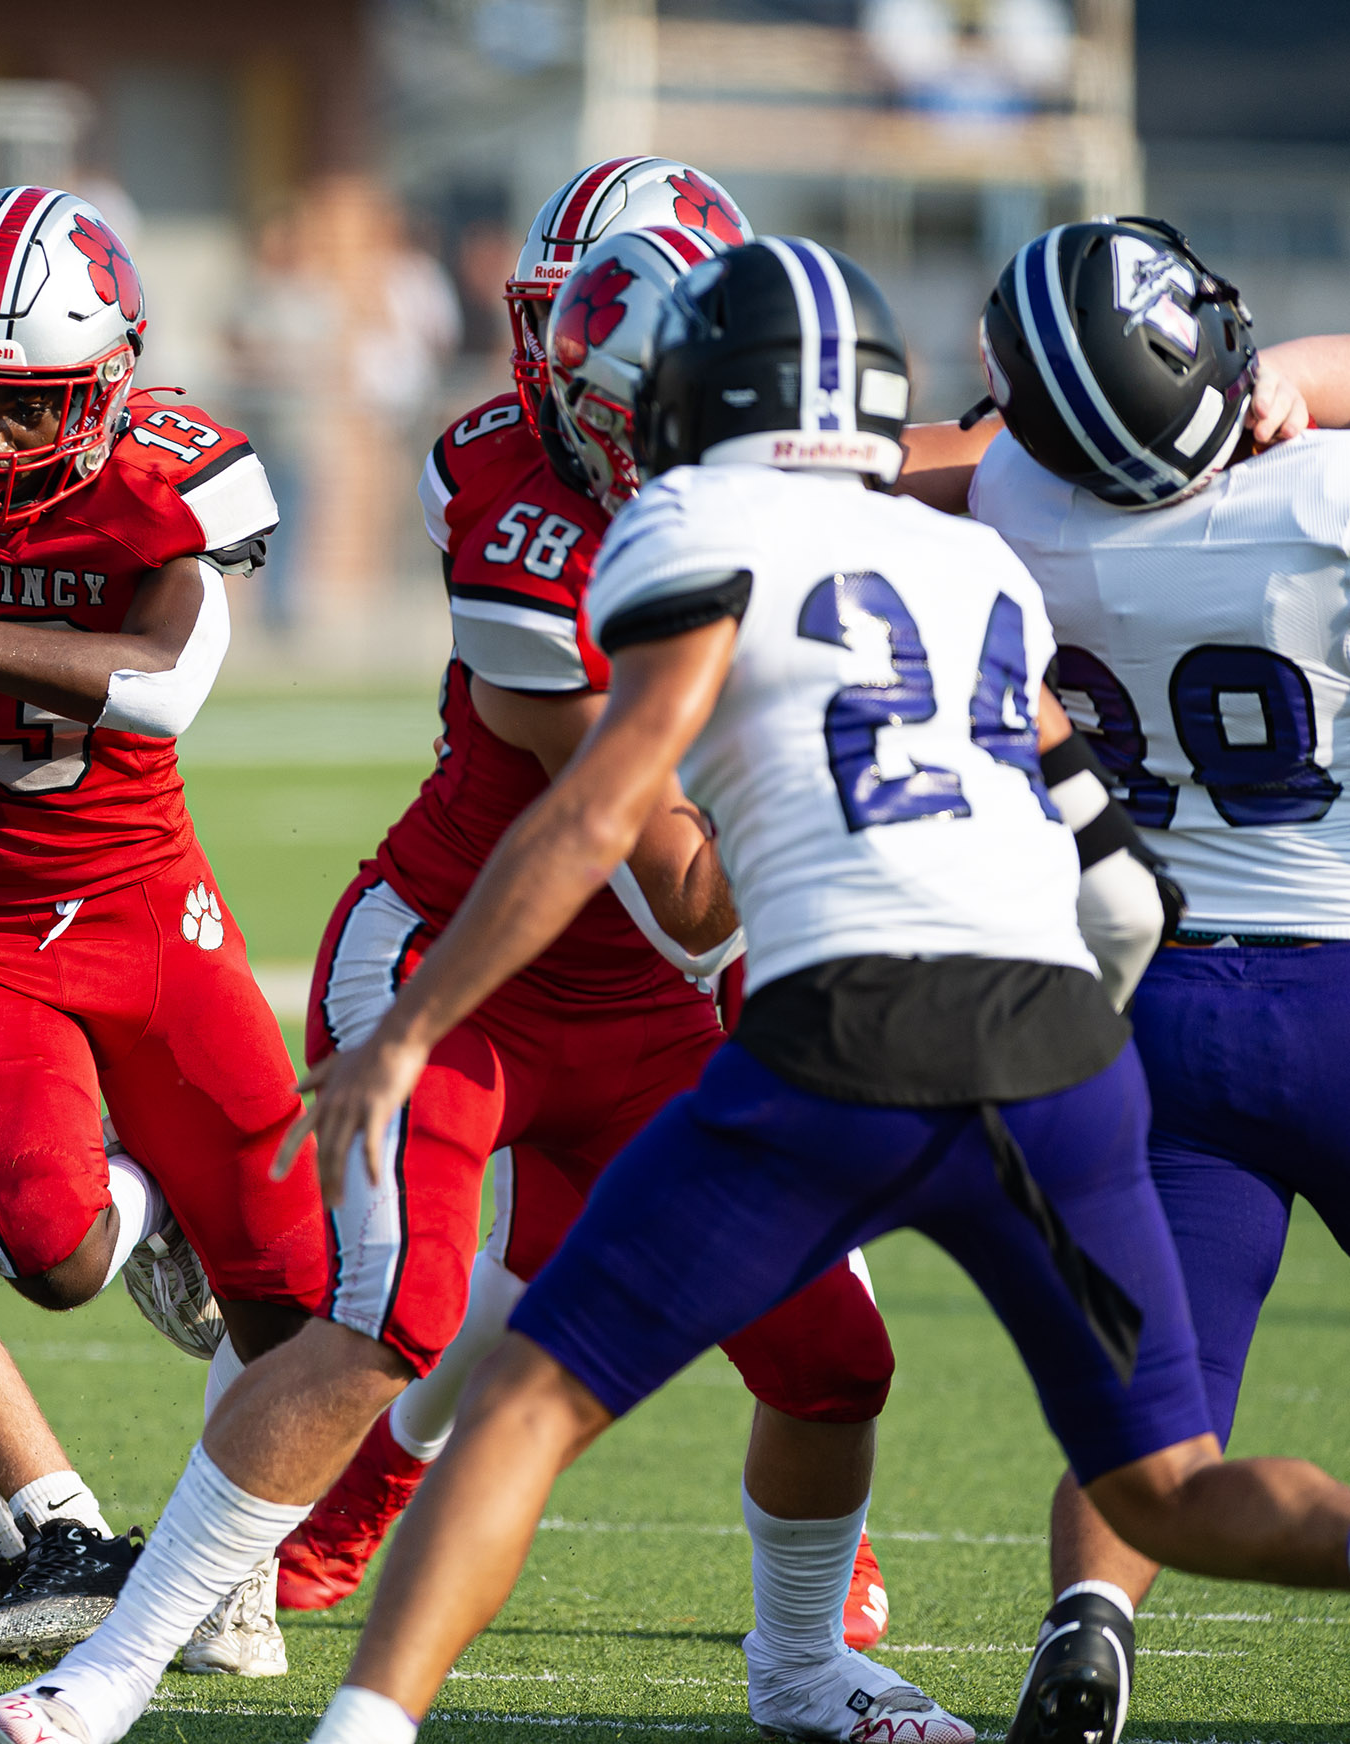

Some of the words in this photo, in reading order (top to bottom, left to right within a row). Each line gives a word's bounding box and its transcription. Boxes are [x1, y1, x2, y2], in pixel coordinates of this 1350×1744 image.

[534, 266, 572, 279] Ridde
[130, 409, 222, 465] 13
[453, 403, 522, 447] 9
[482, 500, 585, 581] 58
[796, 569, 1063, 834] 24
